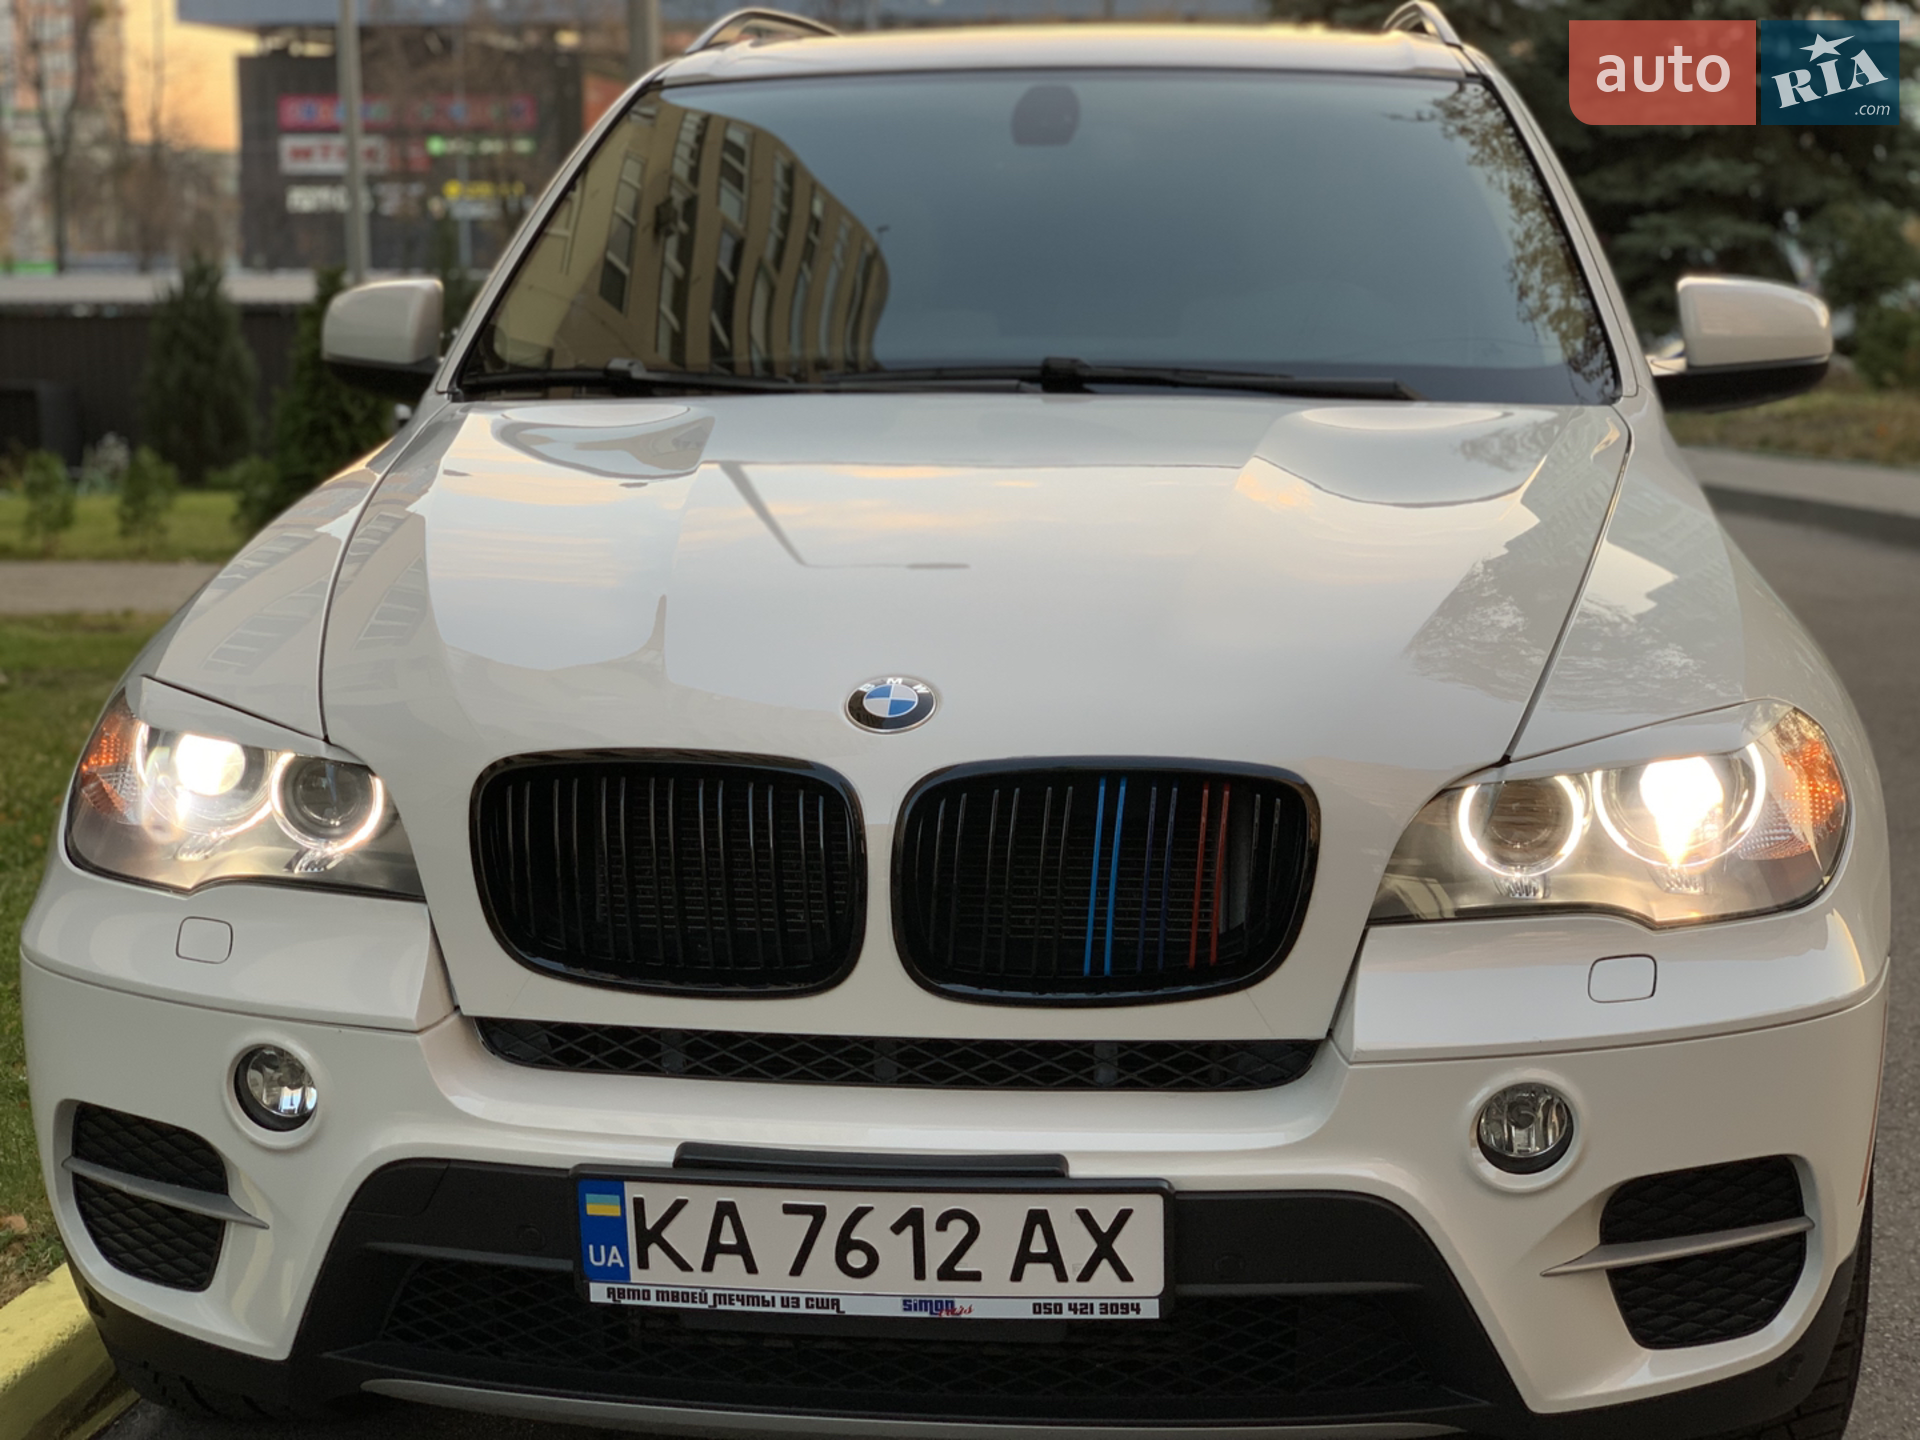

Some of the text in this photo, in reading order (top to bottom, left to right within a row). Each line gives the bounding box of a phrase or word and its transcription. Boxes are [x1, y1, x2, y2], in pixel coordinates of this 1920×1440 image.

[632, 1194, 1134, 1282] KA 7612 AX
[588, 1244, 625, 1268] UA
[1032, 1302, 1142, 1315] 050 421 3094
